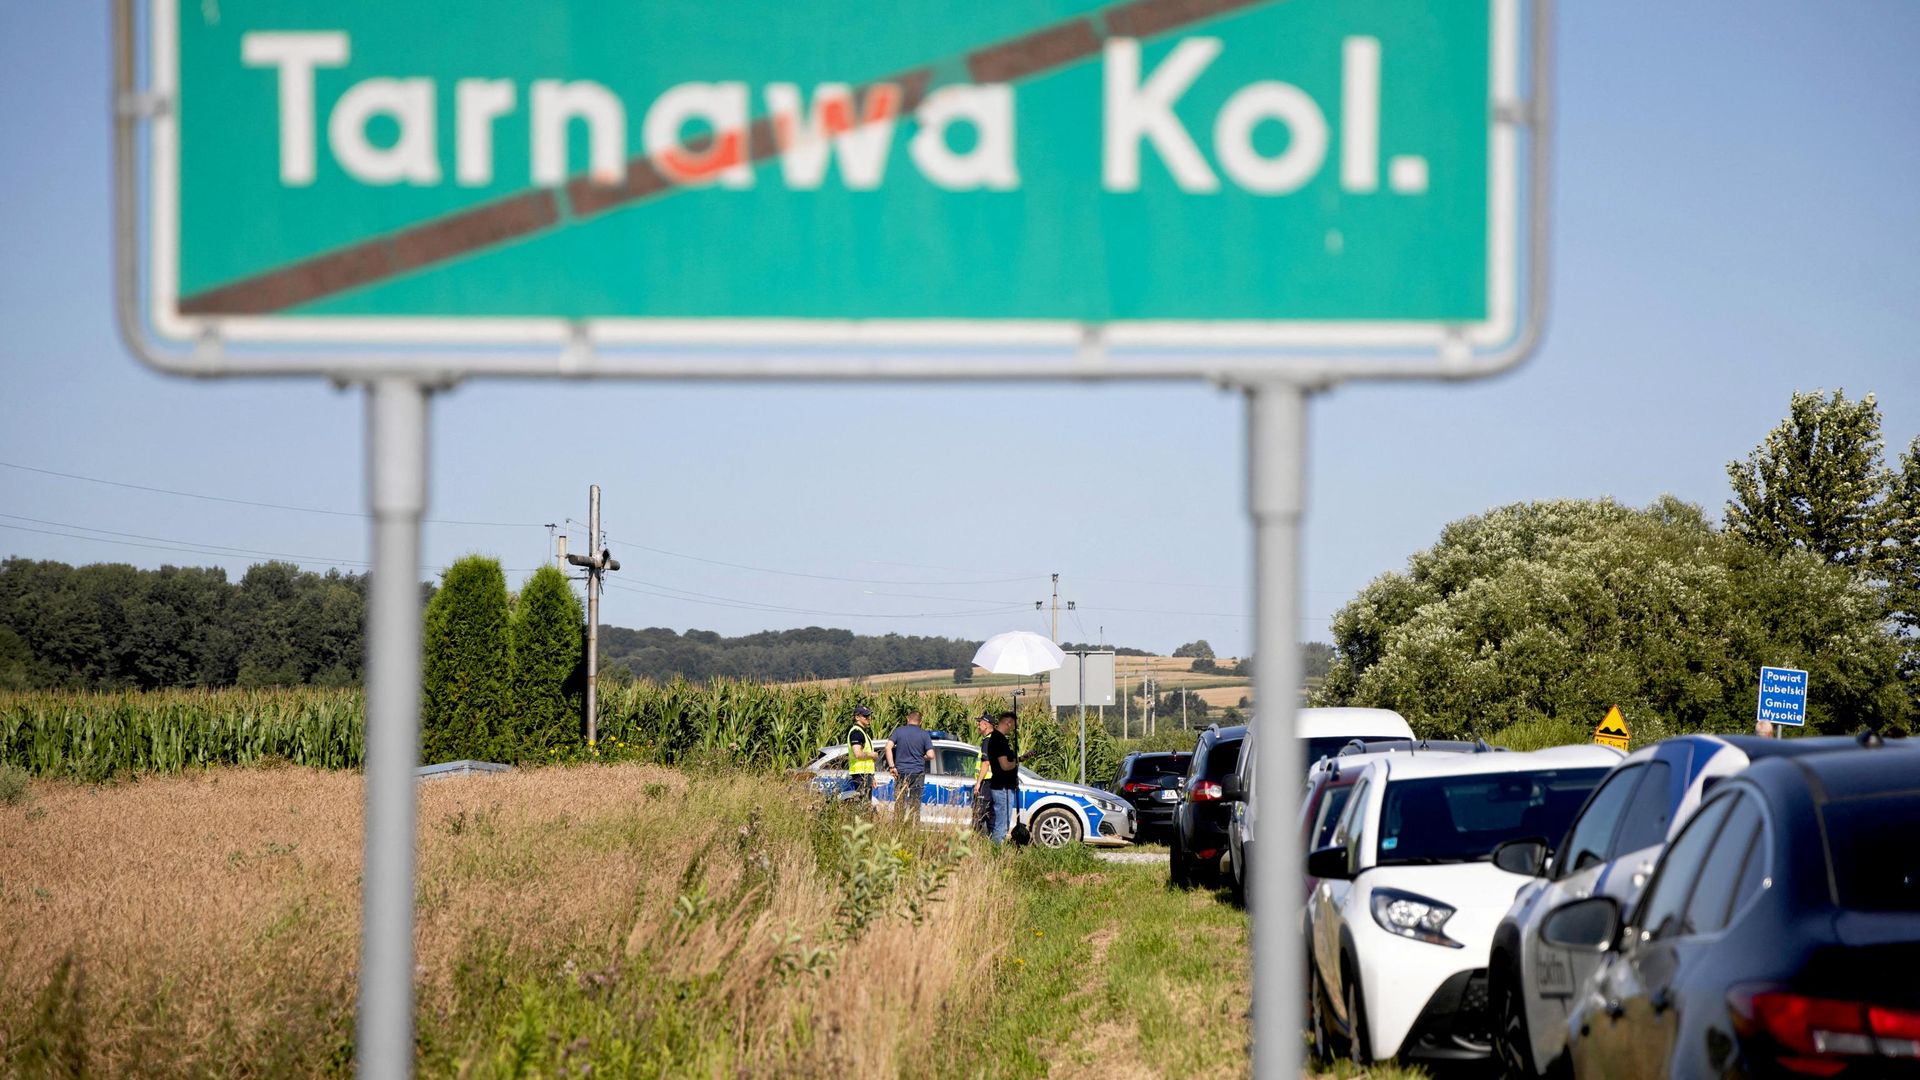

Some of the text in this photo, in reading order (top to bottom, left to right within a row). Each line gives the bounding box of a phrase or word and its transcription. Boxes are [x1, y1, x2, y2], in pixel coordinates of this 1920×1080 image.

[240, 30, 1430, 195] Tarnawa Kol.
[1767, 671, 1801, 683] Powiat
[1763, 683, 1804, 696] Lubelski
[1765, 698, 1799, 710] Gmina
[1761, 708, 1803, 721] Wysokie
